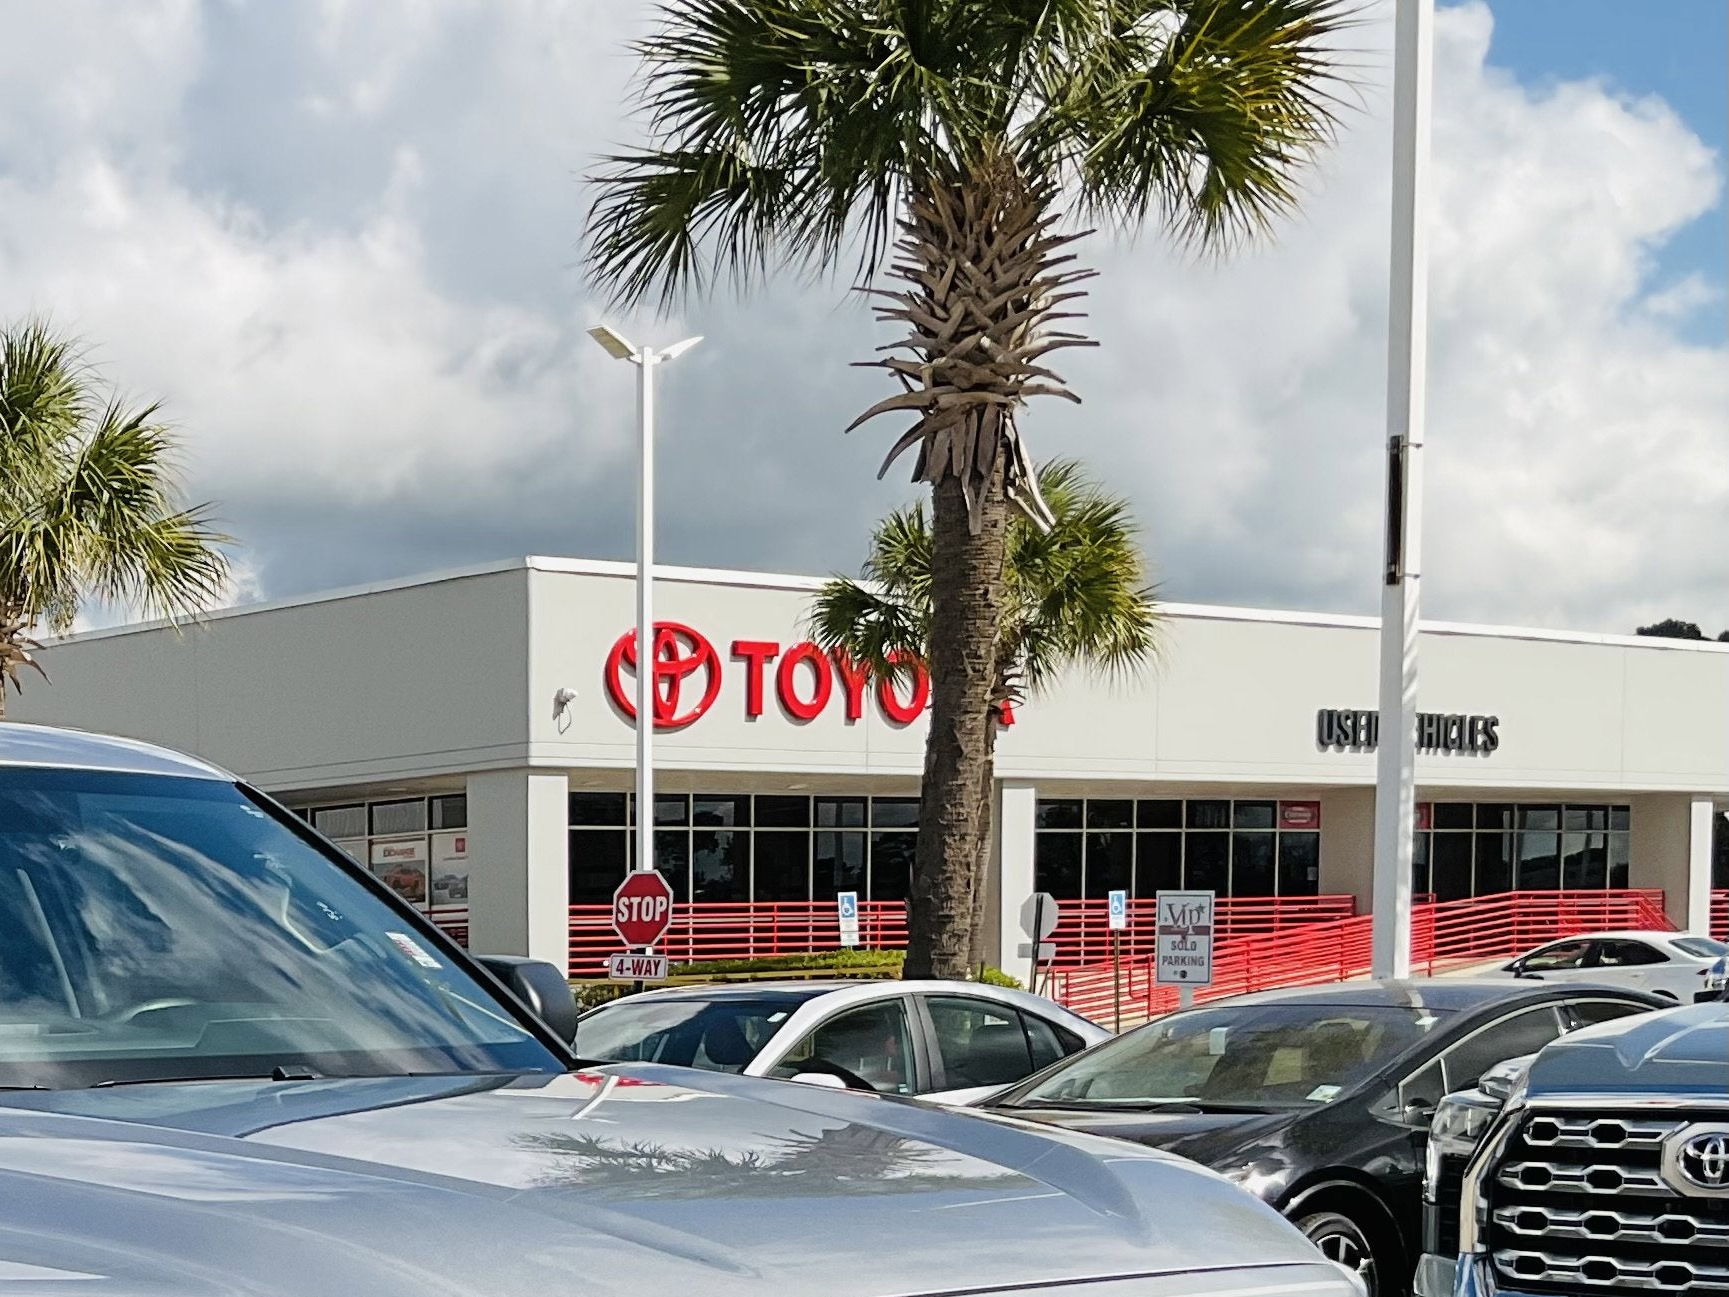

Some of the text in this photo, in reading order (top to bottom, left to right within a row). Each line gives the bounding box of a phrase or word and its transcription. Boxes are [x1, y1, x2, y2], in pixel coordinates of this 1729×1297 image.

[731, 640, 1016, 725] TOYO
[1415, 712, 1499, 752] HICLES
[617, 896, 668, 922] STOP
[1170, 941, 1197, 951] SOLD
[616, 958, 661, 976] 4-WAY
[1162, 956, 1205, 967] PARKING
